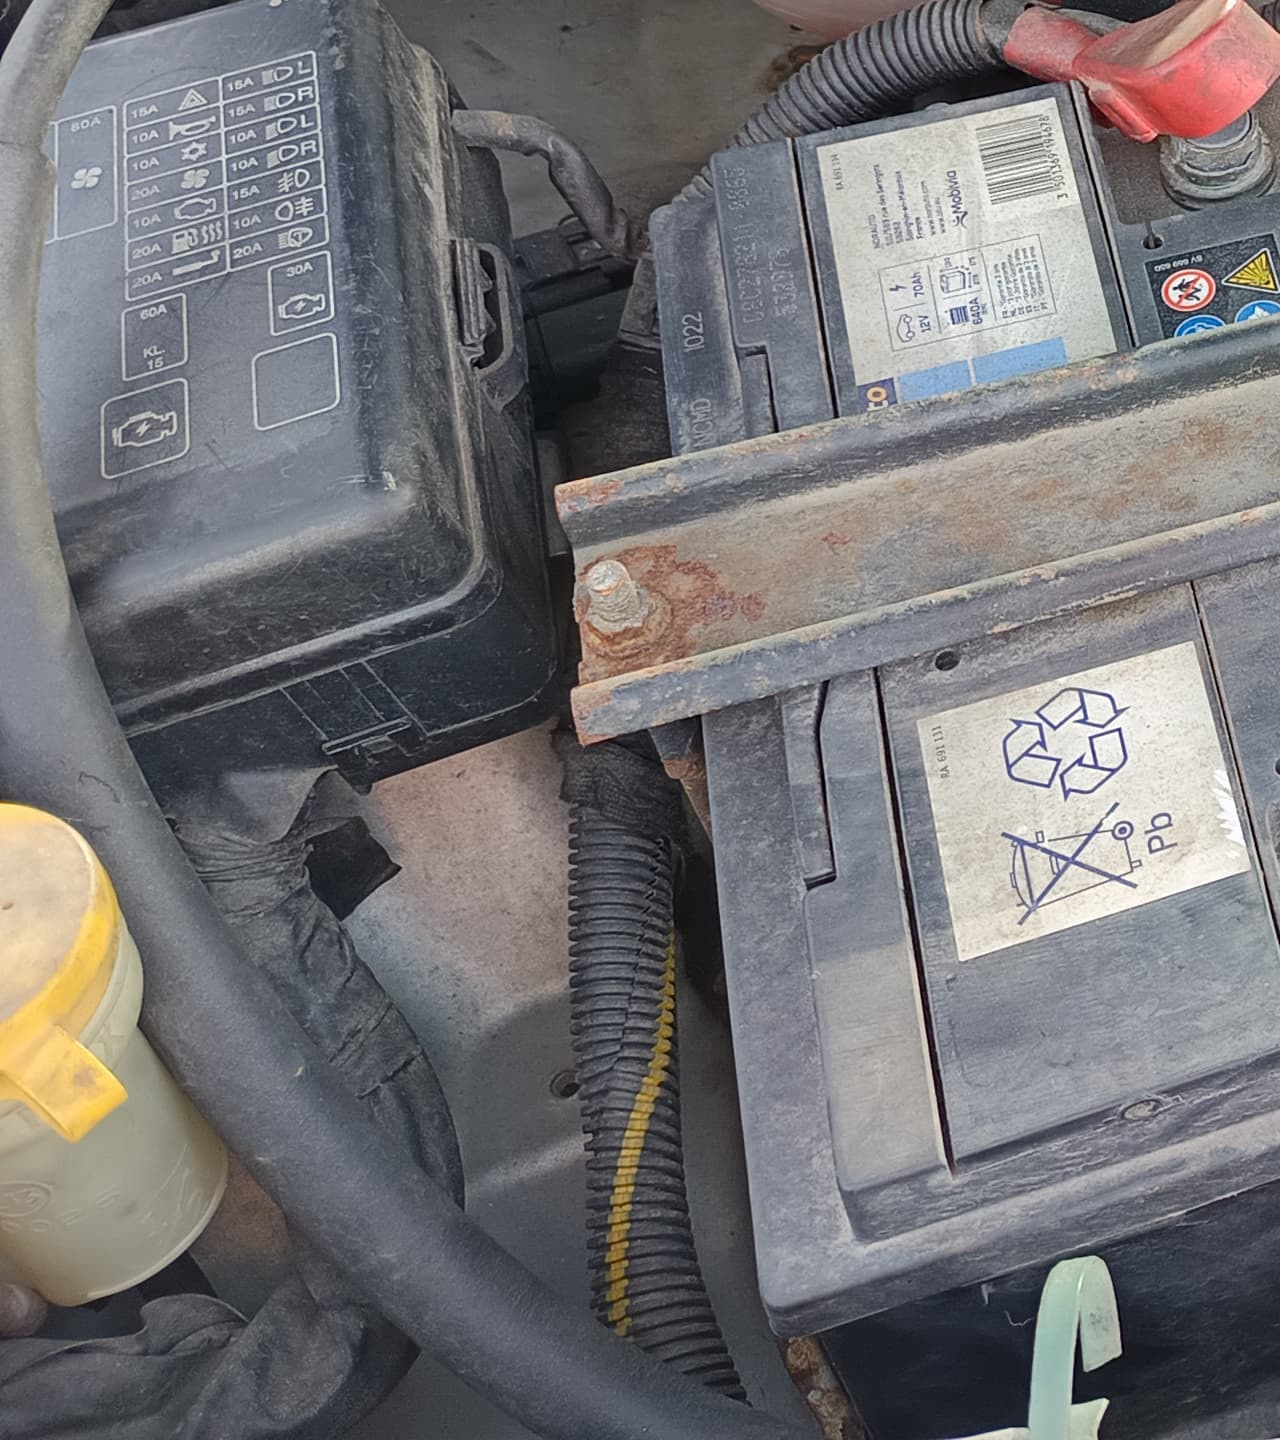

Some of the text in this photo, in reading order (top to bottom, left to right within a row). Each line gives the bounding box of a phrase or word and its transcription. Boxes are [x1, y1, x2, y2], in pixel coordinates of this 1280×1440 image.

[226, 61, 311, 91] 15A L
[228, 86, 314, 118] 15A R
[131, 105, 158, 119] 15A
[132, 130, 159, 144] 10A
[229, 115, 314, 144] 10A L
[132, 157, 160, 171] 10A
[231, 140, 317, 171] 10A R
[1048, 152, 1065, 186] 501369
[131, 185, 160, 201] 20A
[232, 185, 260, 200] 15A
[946, 170, 963, 214] Mobivia
[133, 214, 161, 229] 10A
[233, 216, 261, 230] 10A
[915, 217, 924, 239] France
[132, 243, 162, 259] 20A
[233, 243, 263, 259] 20A
[286, 262, 314, 277] 30A
[132, 272, 163, 288] 20A
[911, 272, 925, 298] 70Ah
[140, 304, 168, 319] 60A
[969, 297, 983, 325] 640A
[682, 311, 705, 353] 1022
[918, 315, 931, 333] 12V
[147, 357, 164, 369] 15
[931, 725, 943, 742] 131
[936, 743, 948, 763] 691
[1145, 811, 1178, 854] Pb
